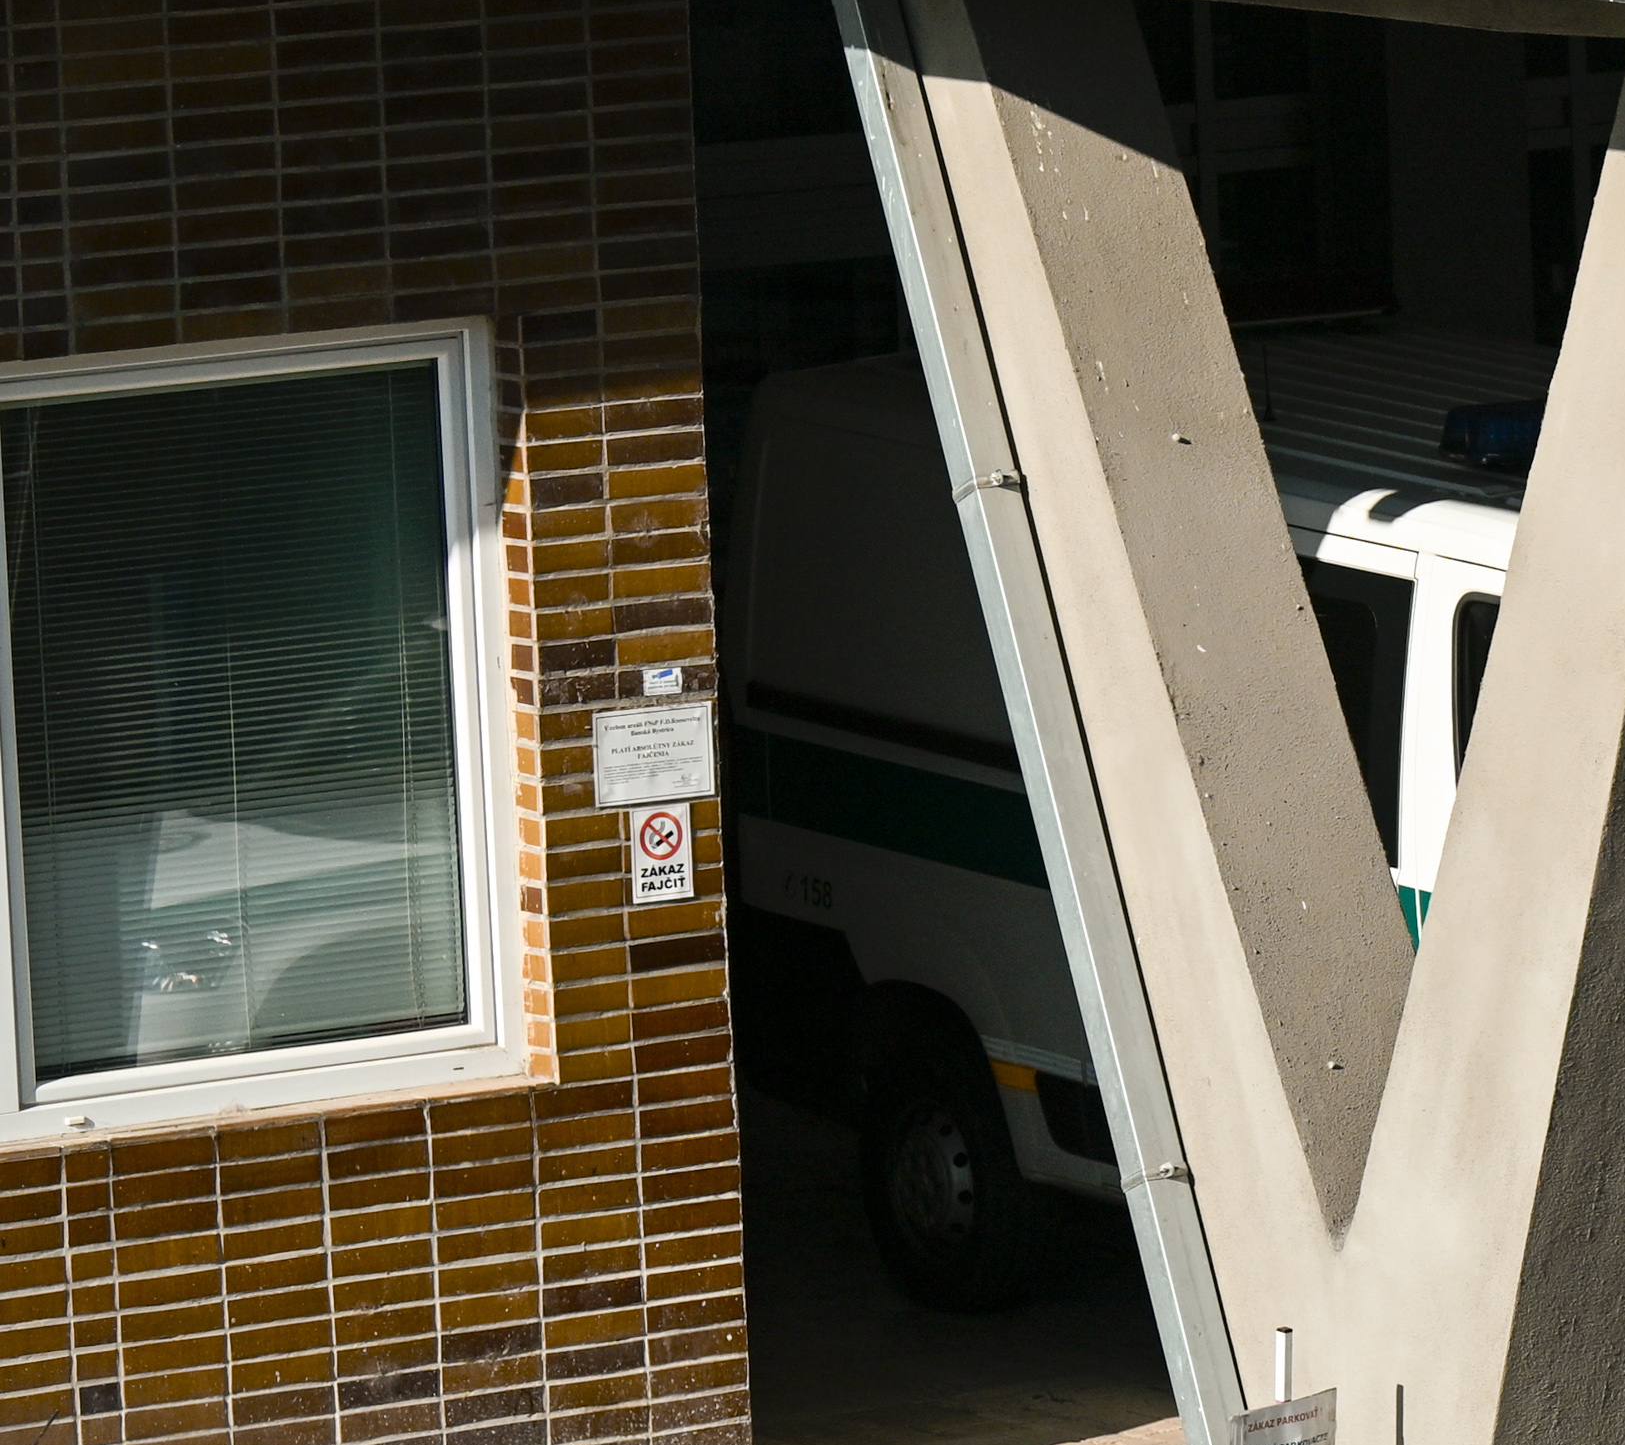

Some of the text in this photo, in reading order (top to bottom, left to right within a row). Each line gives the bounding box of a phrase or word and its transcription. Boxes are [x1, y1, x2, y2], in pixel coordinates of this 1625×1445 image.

[641, 864, 685, 878] ZÁKAZ
[641, 876, 685, 892] FAJČIŤ
[801, 880, 832, 910] 158
[1247, 1418, 1275, 1433] ZÁKAZ
[1276, 1407, 1319, 1426] PARKOVAŤ
